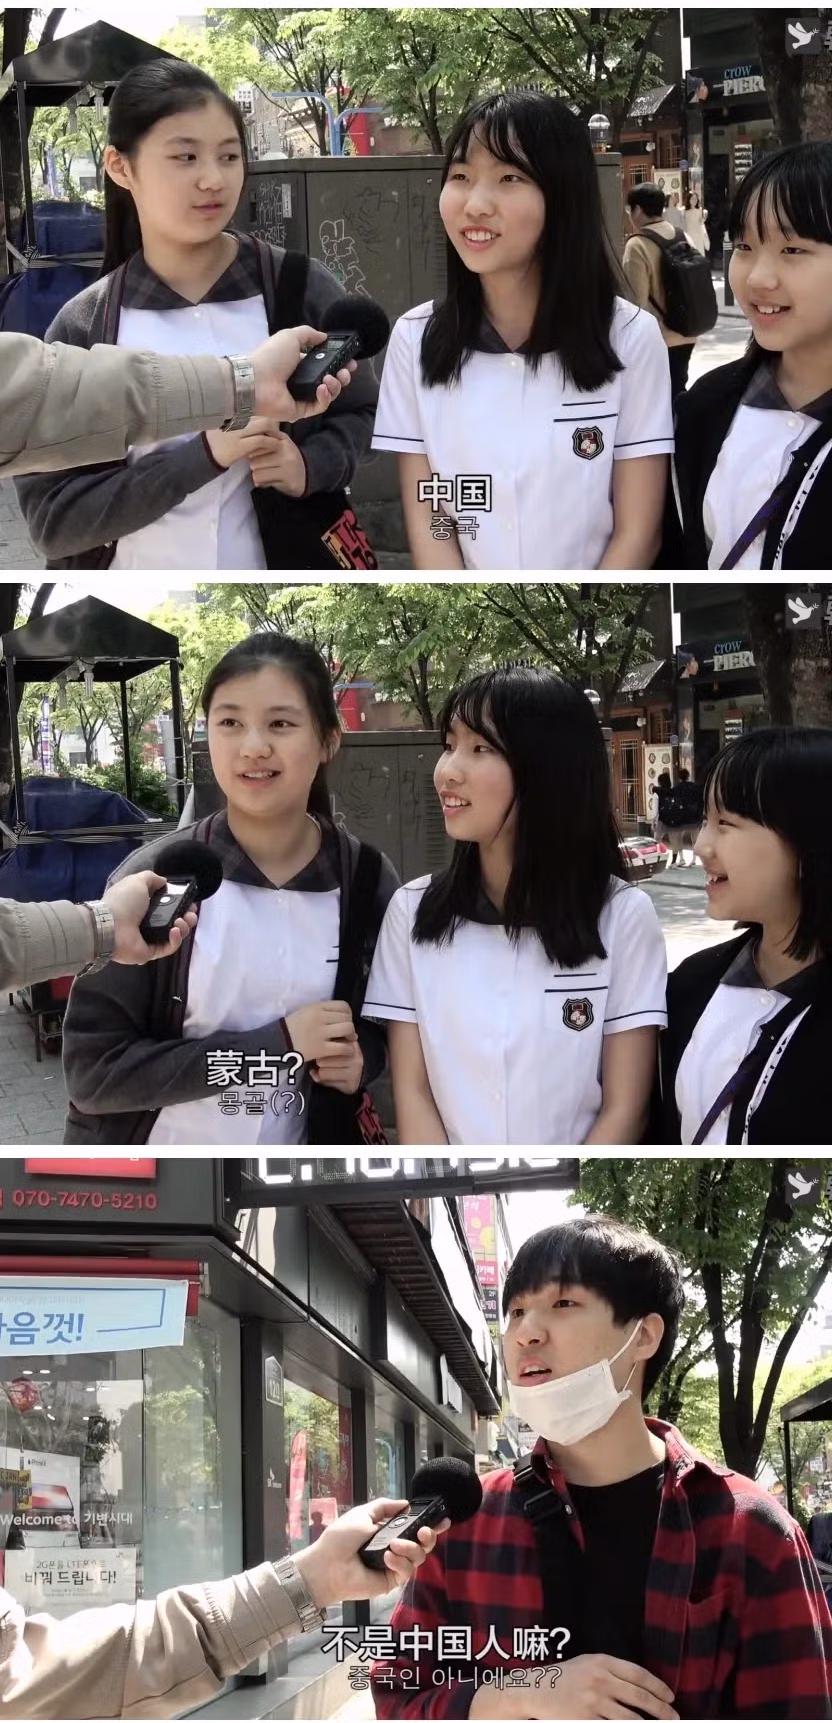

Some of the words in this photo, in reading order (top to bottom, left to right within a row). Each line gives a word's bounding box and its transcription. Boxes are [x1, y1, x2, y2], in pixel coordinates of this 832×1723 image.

[12, 1189, 158, 1210] 070-7470-5210
[0, 1514, 64, 1527] Welcome
[84, 1511, 133, 1527] 기변시대
